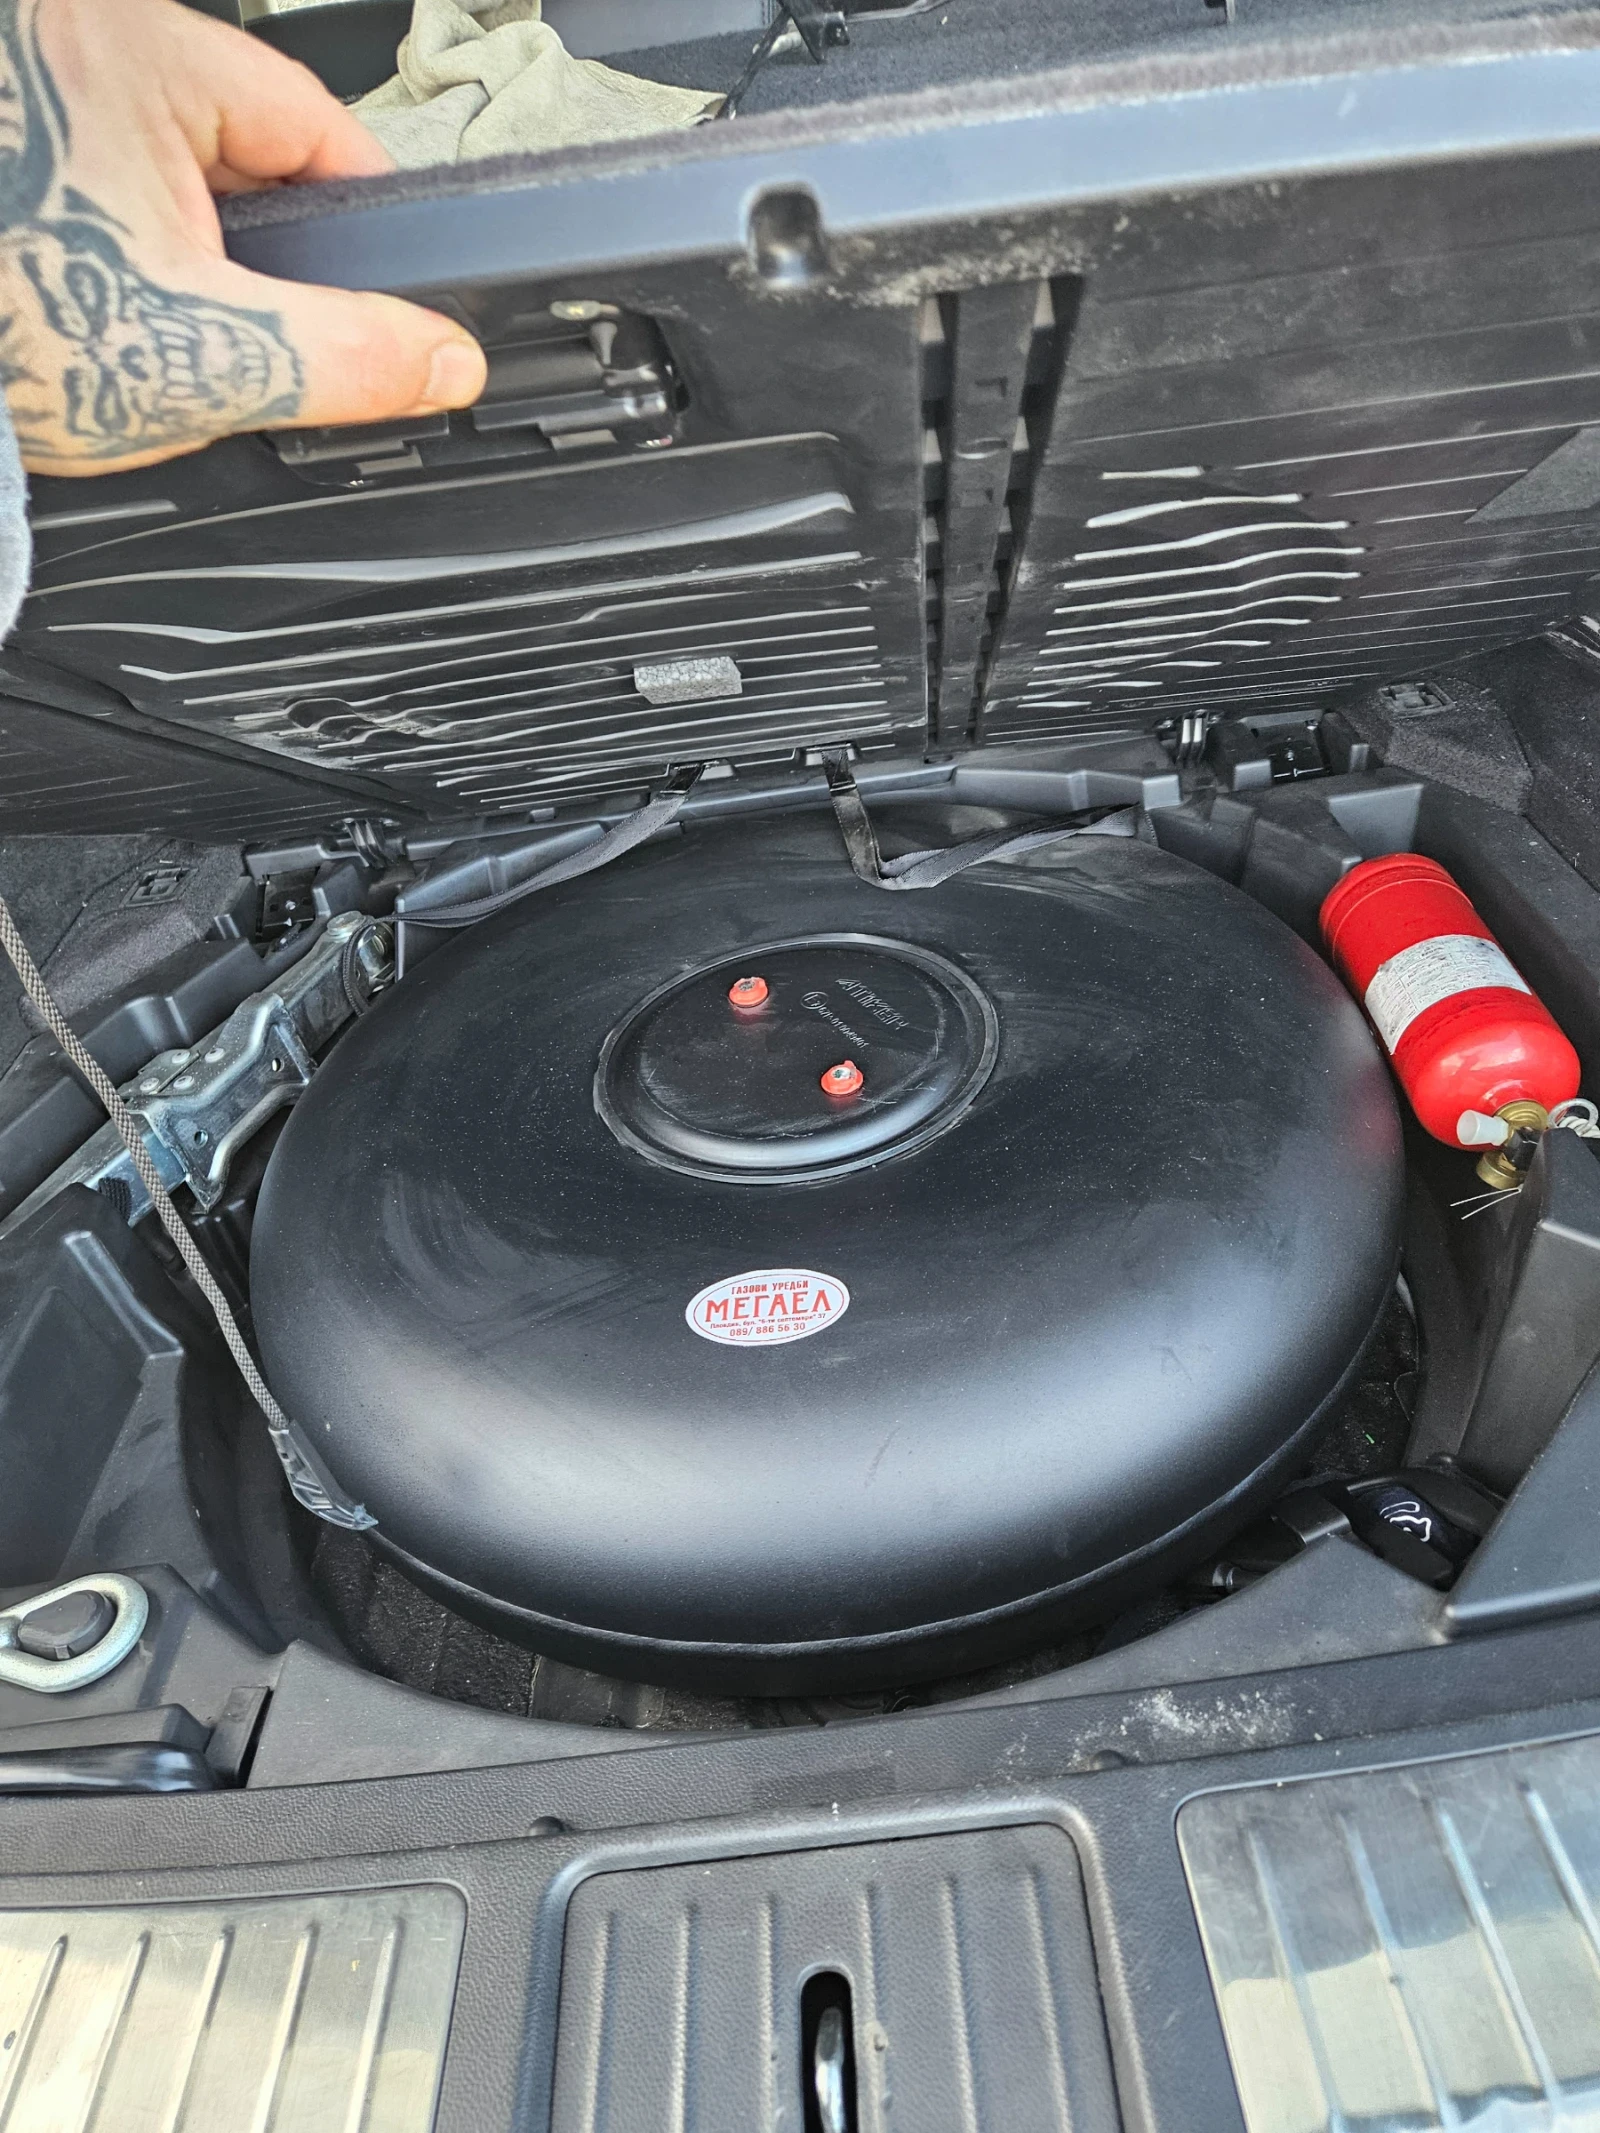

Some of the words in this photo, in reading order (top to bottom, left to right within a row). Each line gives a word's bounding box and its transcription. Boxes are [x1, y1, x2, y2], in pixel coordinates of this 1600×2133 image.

[731, 1283, 768, 1295] ГАЗОВИ
[772, 1280, 809, 1291] УРЕДБИ
[705, 1289, 832, 1323] МЕГАЕЛ
[817, 1312, 827, 1320] 37
[729, 1326, 752, 1338] 089/
[755, 1323, 774, 1335] 886
[778, 1322, 790, 1333] 56
[793, 1321, 806, 1332] 30
